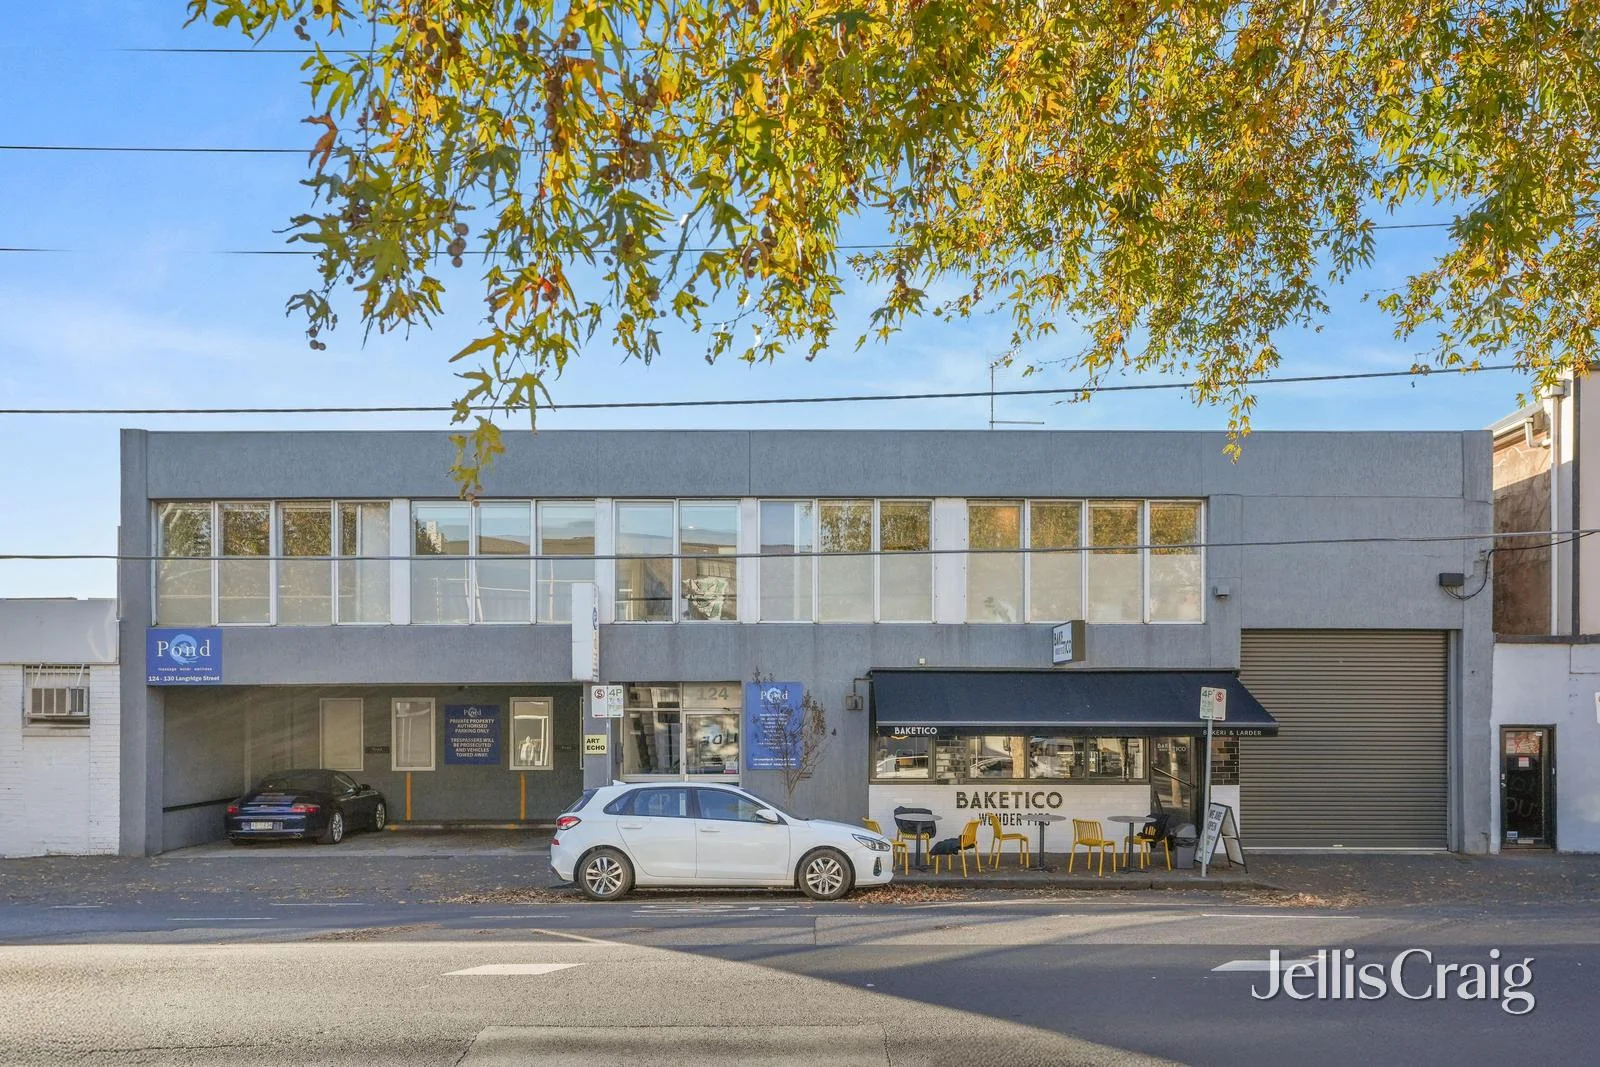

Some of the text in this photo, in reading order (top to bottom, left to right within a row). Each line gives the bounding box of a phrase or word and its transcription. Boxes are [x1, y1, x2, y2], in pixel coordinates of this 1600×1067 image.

[157, 640, 211, 657] Pond
[609, 689, 622, 697] 4P
[697, 687, 729, 700] 124
[1201, 690, 1213, 698] 4P
[894, 726, 938, 735] BAKETICO
[956, 791, 1063, 809] BAKETICO
